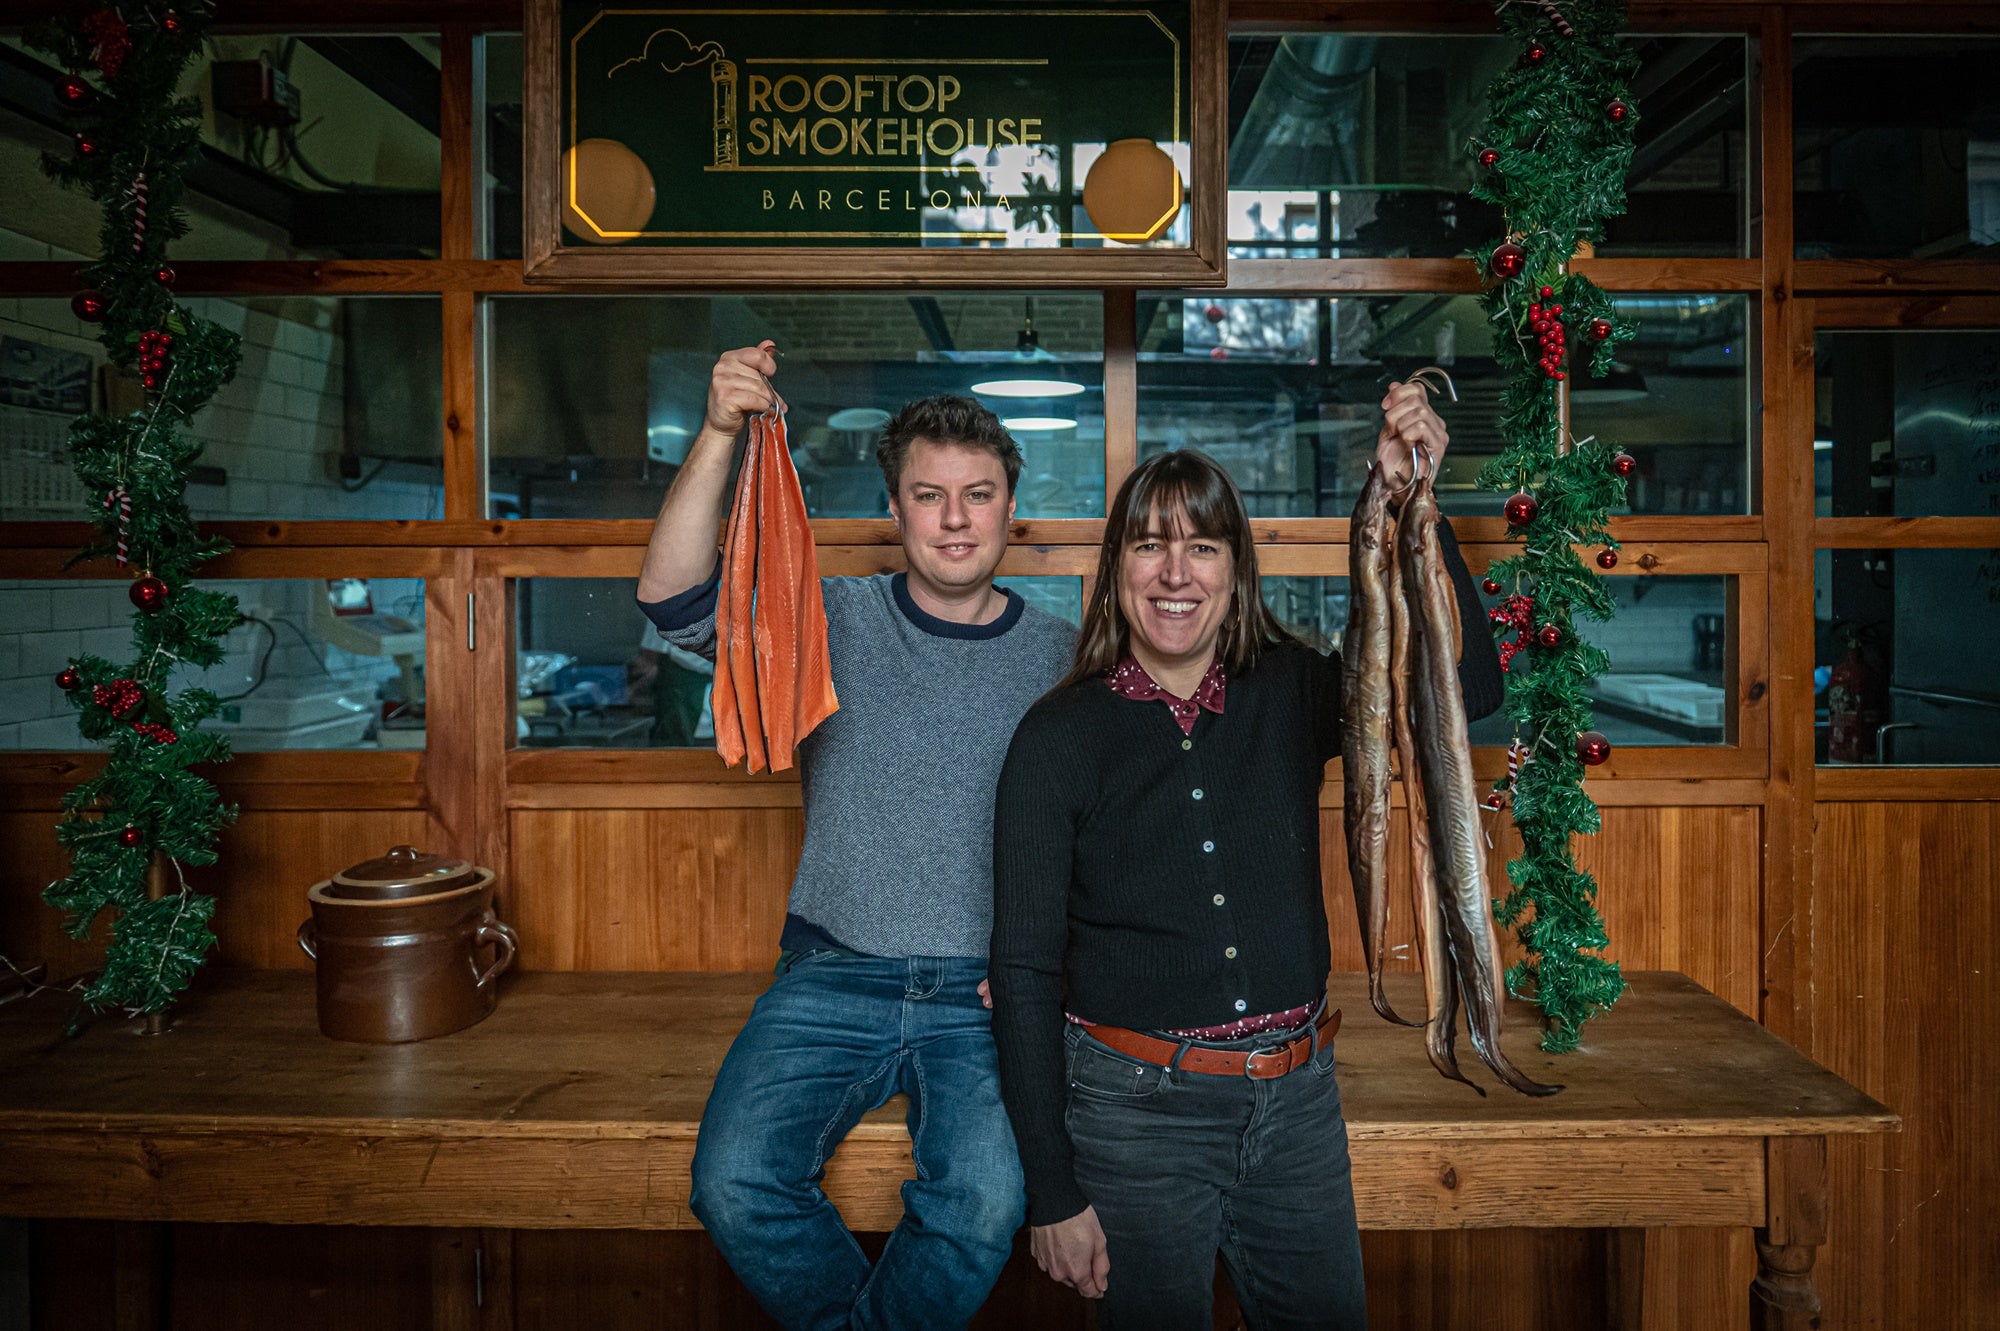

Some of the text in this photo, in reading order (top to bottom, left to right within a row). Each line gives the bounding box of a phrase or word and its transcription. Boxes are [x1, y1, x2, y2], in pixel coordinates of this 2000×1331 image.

[748, 74, 961, 113] ROOFTOP
[747, 118, 1043, 156] SMOKEHOUSE
[762, 189, 1012, 211] BARCELONA
